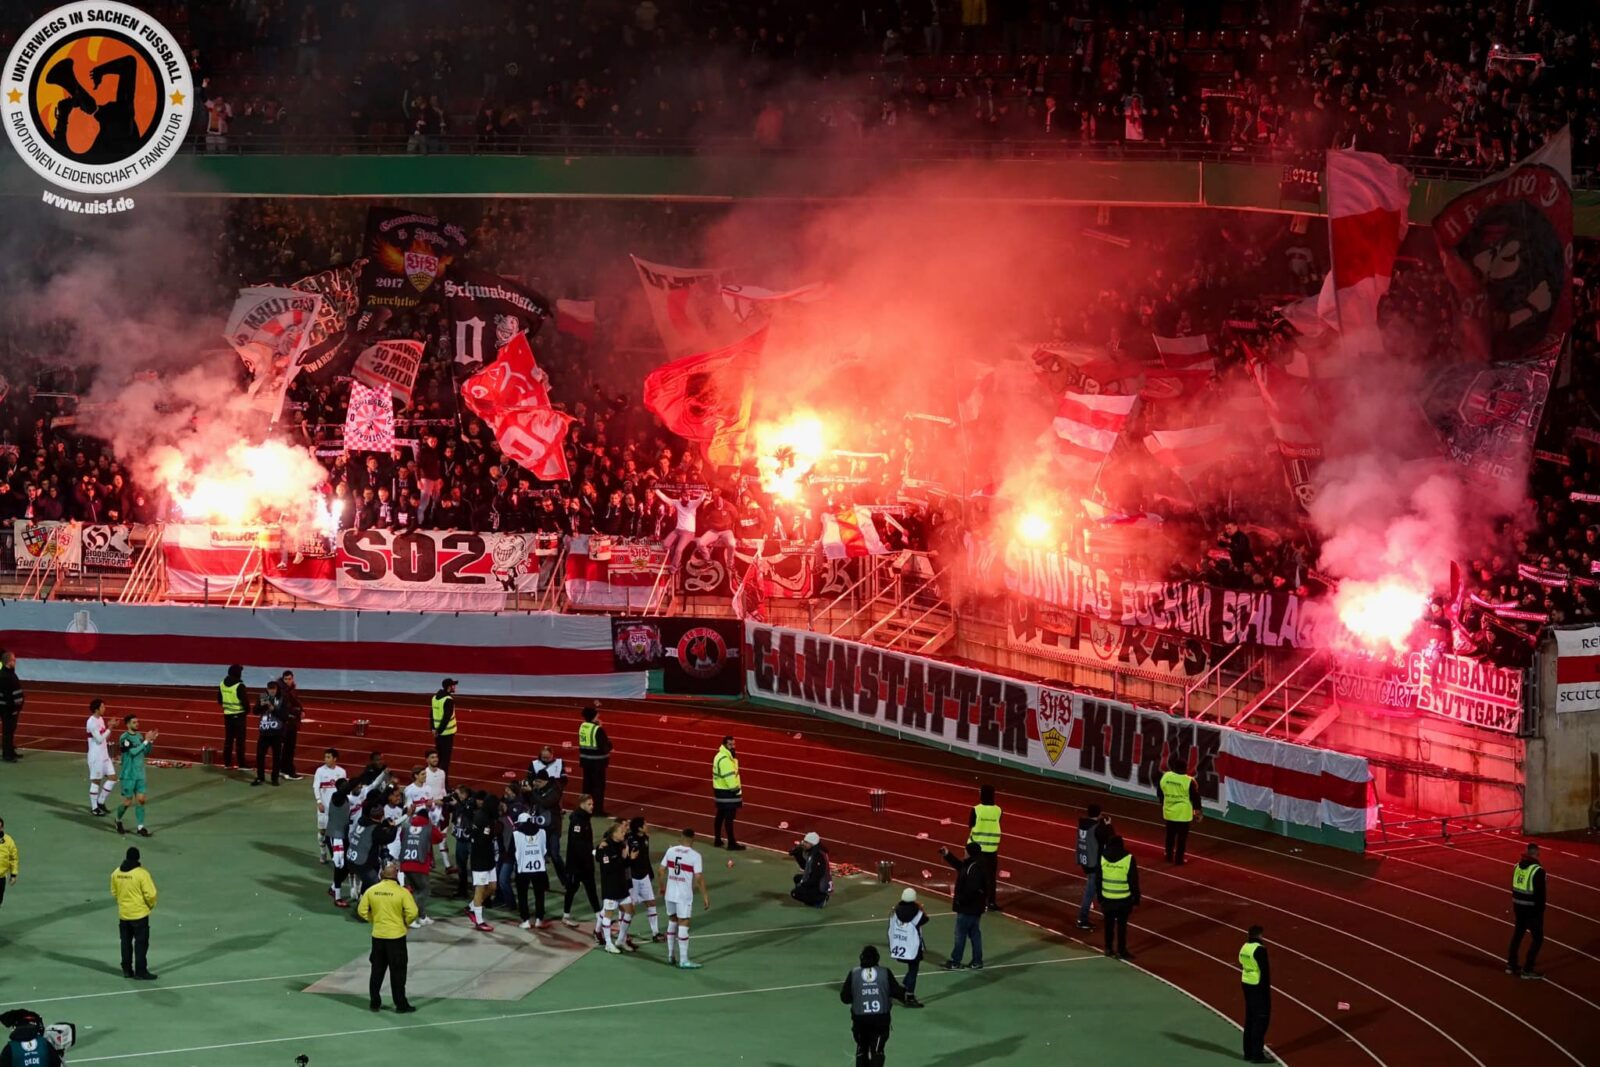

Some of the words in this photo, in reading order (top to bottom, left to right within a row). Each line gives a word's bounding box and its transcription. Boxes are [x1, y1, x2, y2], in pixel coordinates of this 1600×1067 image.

[375, 277, 405, 289] 2017
[1004, 540, 1112, 620] SONNTAG
[1120, 581, 1211, 640] BOCHUM
[1222, 591, 1322, 648] SCHLAG
[752, 627, 1029, 757] CANNSTATTER
[1337, 673, 1415, 708] STUTTGART
[1039, 689, 1073, 726] VfB
[1420, 684, 1517, 729] STUTTGART
[403, 849, 418, 860] 20
[525, 860, 541, 871] 40
[674, 856, 682, 875] 5
[892, 946, 906, 958] 42
[862, 1000, 881, 1013] 19
